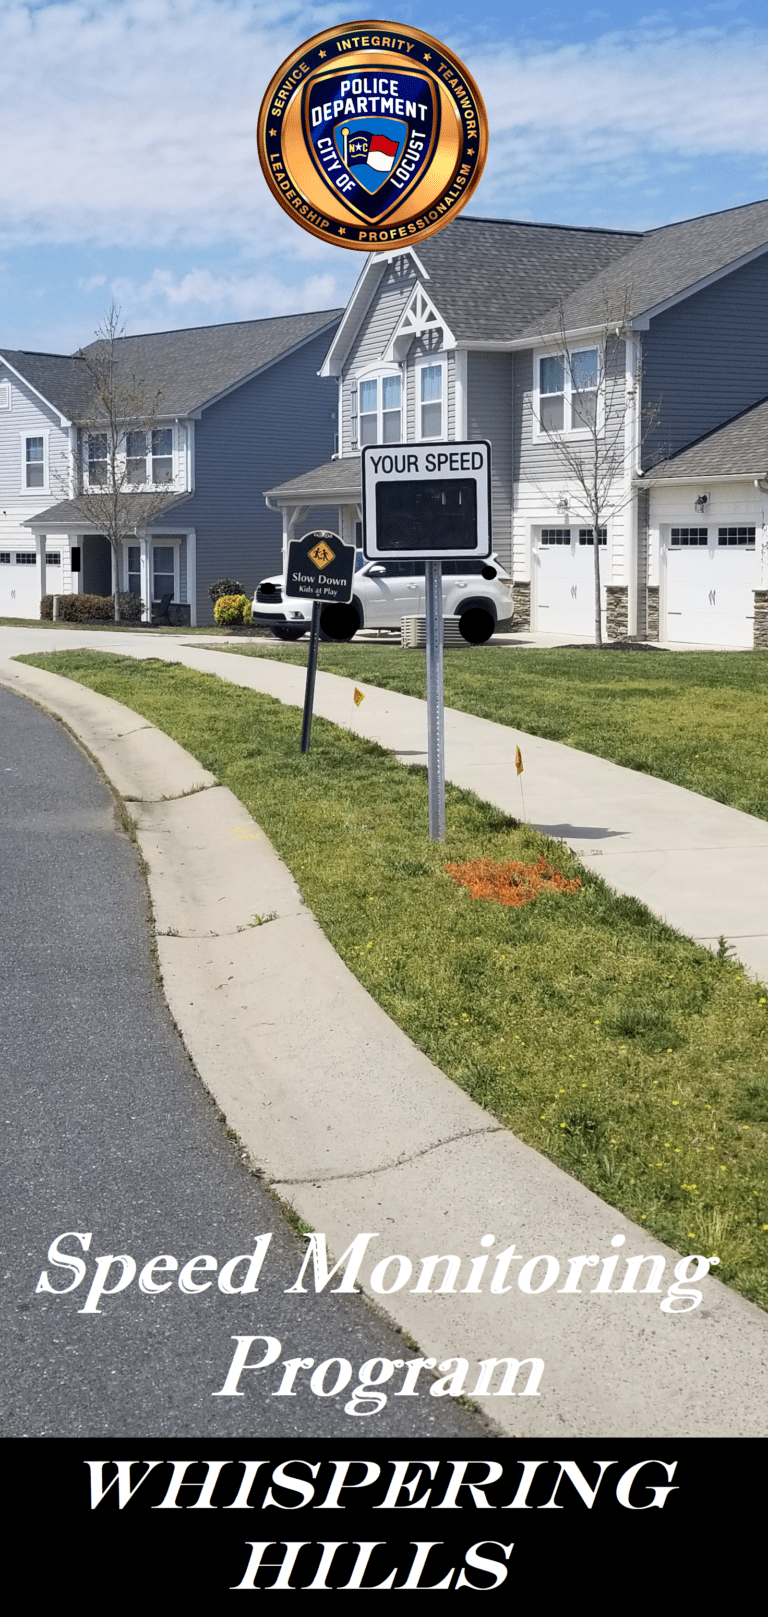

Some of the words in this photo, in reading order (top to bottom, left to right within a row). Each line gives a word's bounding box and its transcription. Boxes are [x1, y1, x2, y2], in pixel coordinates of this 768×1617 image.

[370, 455, 419, 474] YOUR
[425, 452, 484, 472] SPEED
[292, 572, 315, 583] Slow
[318, 575, 347, 586] Down
[299, 585, 313, 594] Kids
[323, 588, 338, 597] Play
